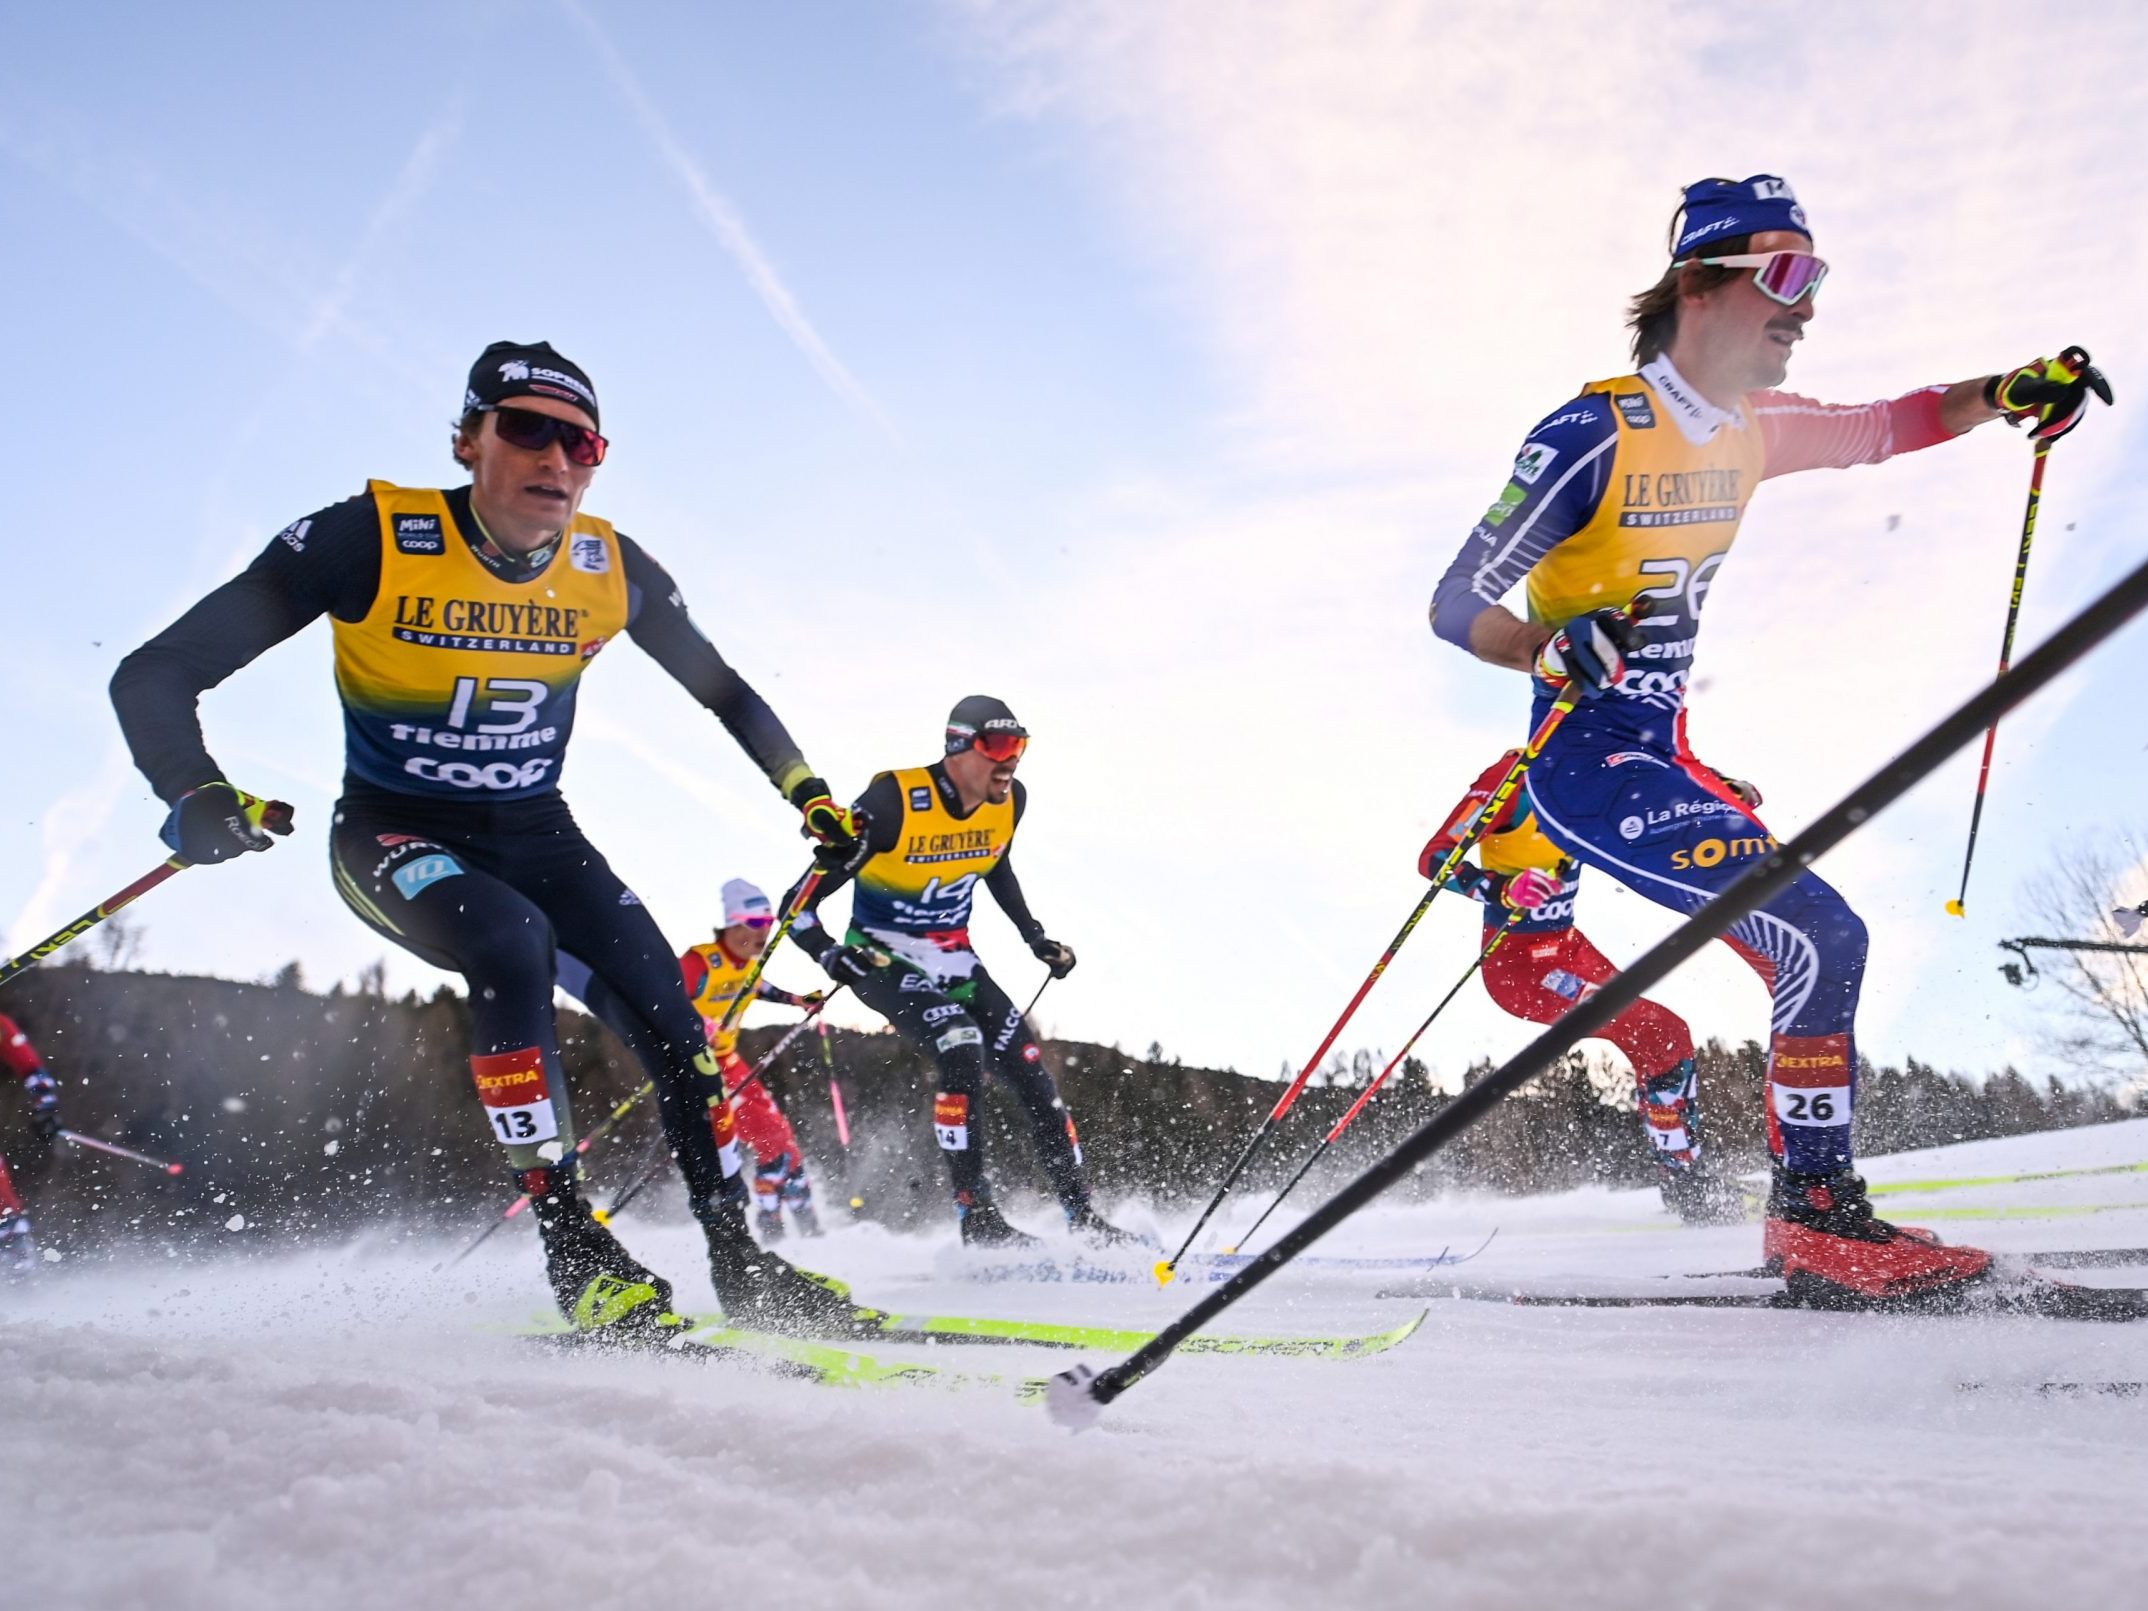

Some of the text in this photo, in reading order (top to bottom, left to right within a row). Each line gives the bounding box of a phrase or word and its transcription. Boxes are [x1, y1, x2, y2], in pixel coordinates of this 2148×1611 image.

[1680, 218, 1726, 246] CRAFT
[1658, 375, 1696, 410] CRAFT
[1623, 474, 1651, 507] LE
[1626, 508, 1735, 526] SWITZERLAND
[402, 539, 438, 550] coop
[394, 595, 579, 638] LE GRUYÈRE
[401, 629, 570, 654] SWITZERLAND
[1612, 669, 1692, 697] coo
[447, 676, 550, 735] 13
[404, 756, 553, 790] coop
[1480, 763, 1530, 824] LEKI
[1647, 811, 1671, 825] La
[908, 829, 991, 853] LE GRUYÈRE
[920, 873, 978, 904] 14
[1530, 900, 1575, 922] coo
[993, 1006, 1022, 1051] FALCO
[1786, 1093, 1834, 1121] 26
[495, 1111, 537, 1138] 13
[937, 1128, 956, 1145] 14
